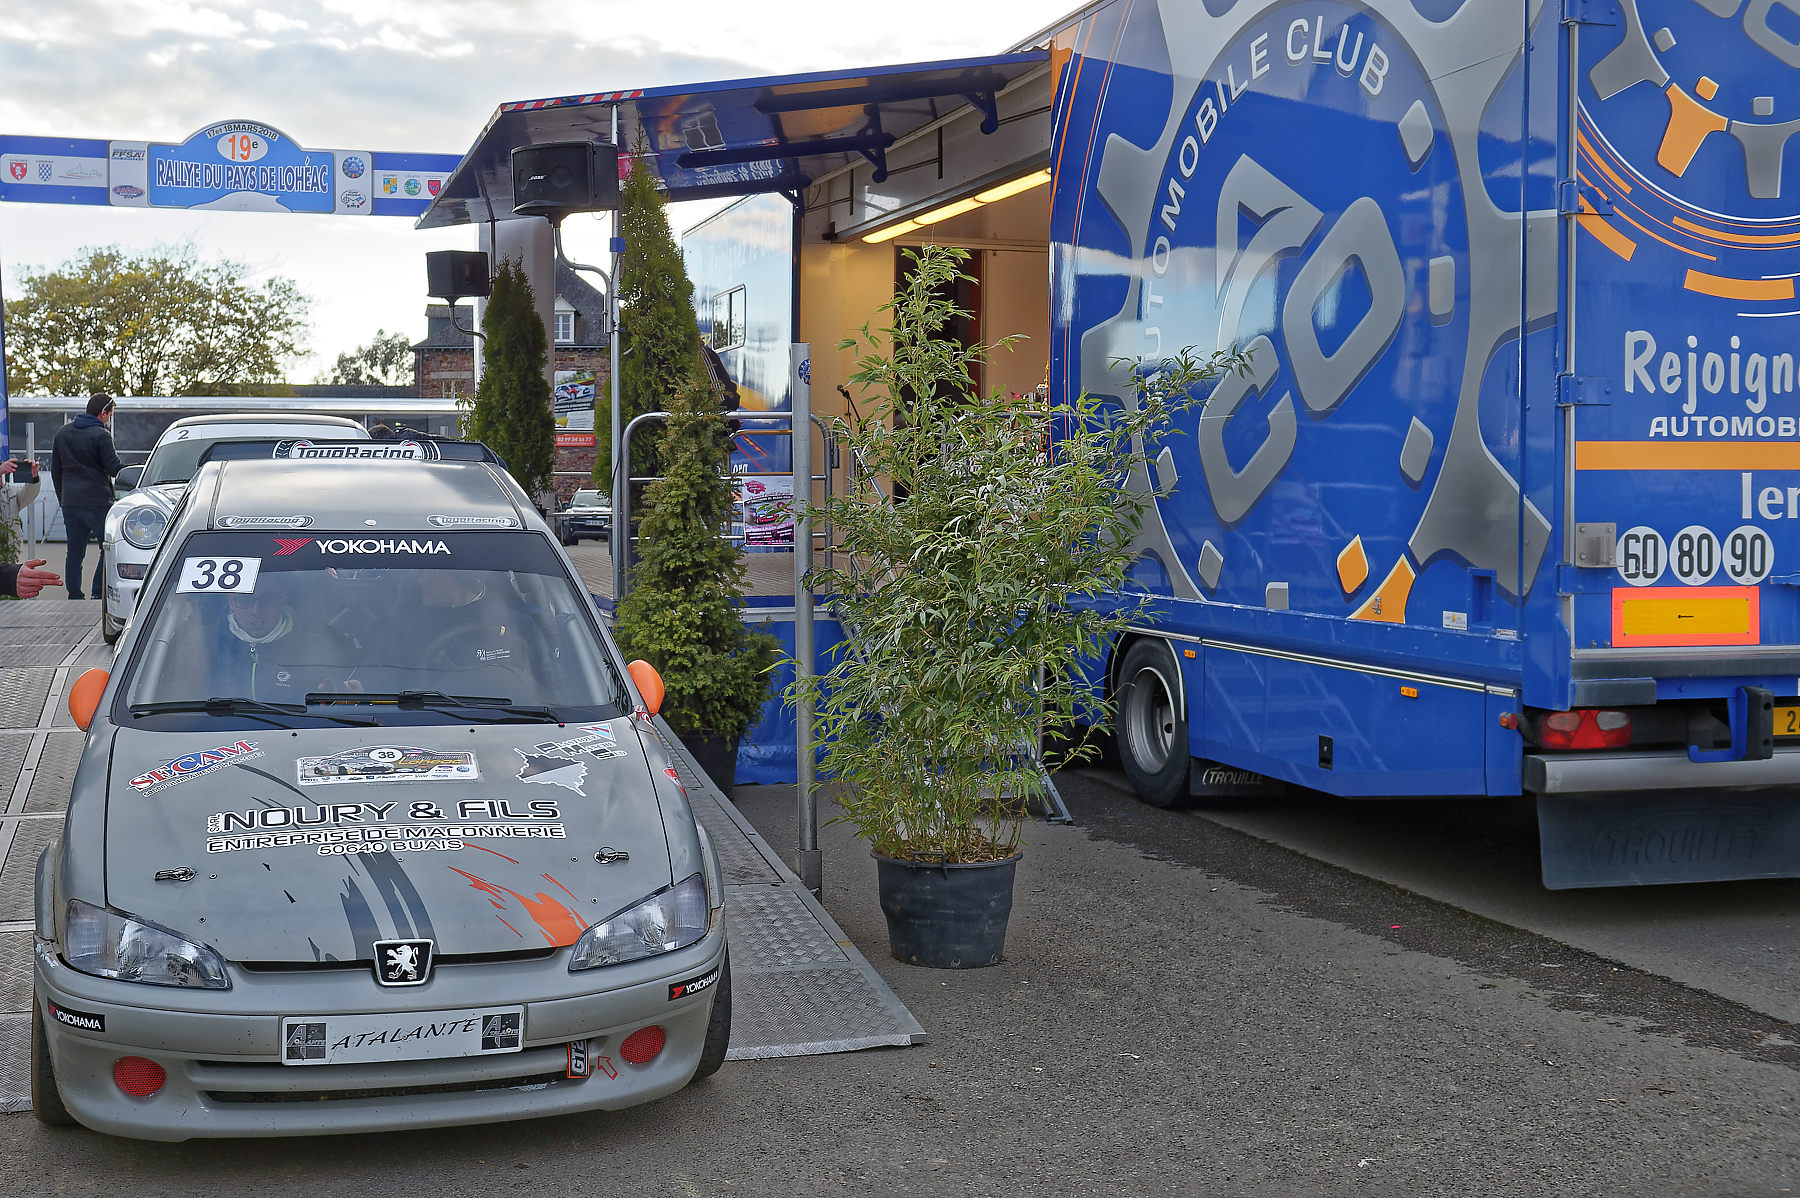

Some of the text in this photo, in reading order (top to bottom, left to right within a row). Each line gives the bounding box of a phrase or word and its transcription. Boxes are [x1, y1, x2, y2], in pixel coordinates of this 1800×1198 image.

[1286, 15, 1389, 97] CLUB
[156, 158, 201, 188] RALLYE
[203, 162, 223, 189] DU
[225, 164, 257, 191] PAYS
[259, 166, 276, 191] DE
[279, 155, 328, 193] LOHÉAC
[1624, 329, 1800, 415] Rejoign
[177, 429, 190, 440] 2
[1649, 415, 1800, 437] AUTOMOB
[315, 539, 452, 555] YOKOHAMA
[1624, 533, 1659, 579] 60
[1677, 532, 1714, 578] 80
[1730, 532, 1767, 578] 90
[191, 559, 244, 590] 38
[1786, 710, 1800, 733] 2
[128, 740, 259, 792] SECAM
[377, 751, 396, 759] 38
[223, 799, 561, 833] NOURY & FILS
[207, 825, 567, 853] ENTREPRISE DE MACONNERIE
[317, 838, 465, 856] 50640 BUAIS
[56, 1009, 102, 1030] YOKOHAMA
[331, 1017, 482, 1051] ATALANTE
